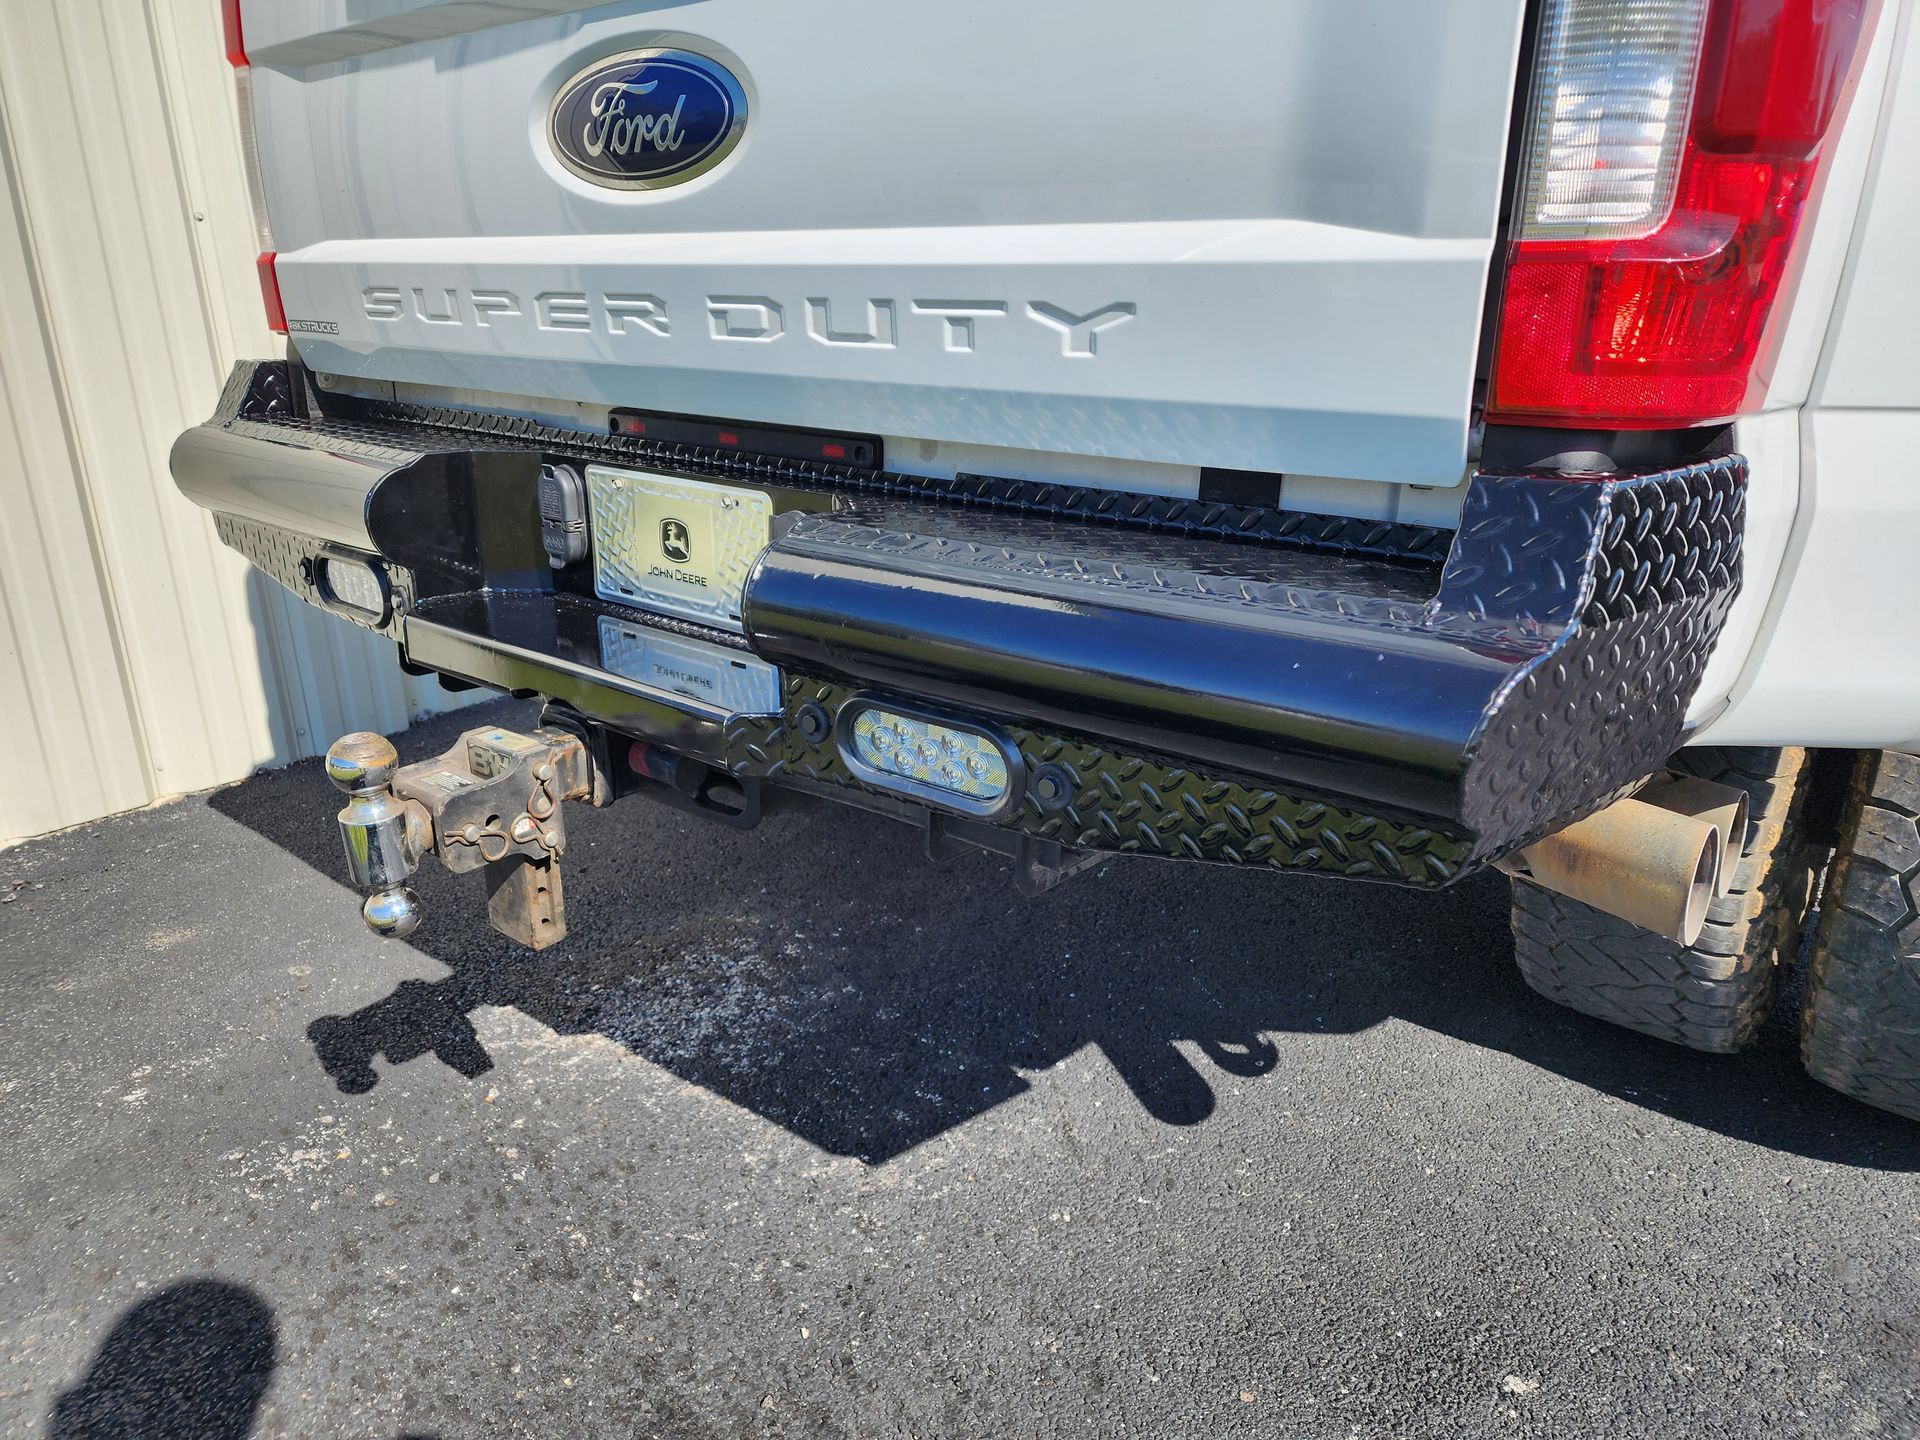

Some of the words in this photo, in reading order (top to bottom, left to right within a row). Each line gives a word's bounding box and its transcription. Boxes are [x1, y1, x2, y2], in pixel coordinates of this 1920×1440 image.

[583, 80, 686, 157] Ford
[361, 286, 672, 338] SUPER
[706, 294, 1137, 357] DUTY
[648, 563, 674, 579] JOHN
[674, 569, 708, 587] DEERE
